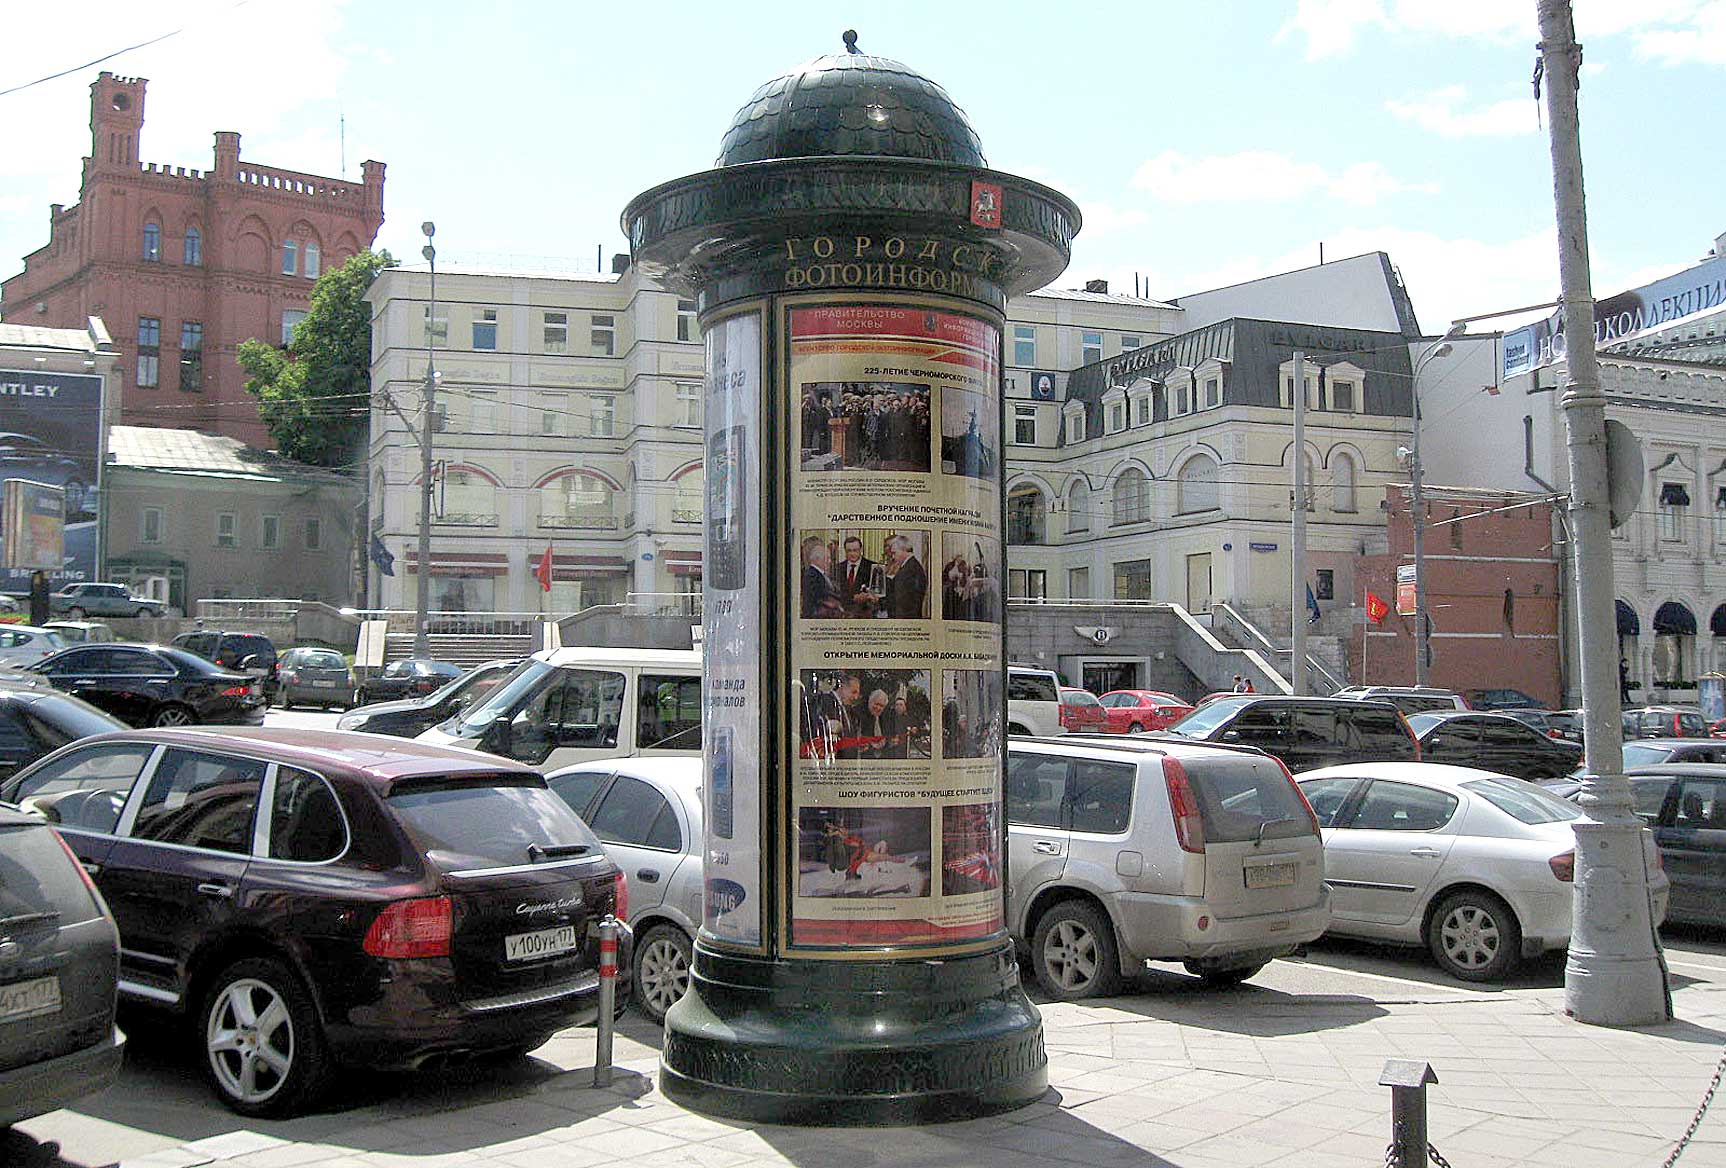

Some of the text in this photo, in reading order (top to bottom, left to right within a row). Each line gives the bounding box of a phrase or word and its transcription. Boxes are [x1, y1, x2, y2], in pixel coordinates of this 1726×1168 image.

[813, 309, 905, 320] ПРАВИТЕЛЬСТВО
[1603, 280, 1726, 343] КОЛЛЕКЦИ
[836, 320, 883, 330] МОСКВЫ
[864, 366, 909, 376] 225-ЛЕТИЕ
[877, 504, 920, 513] ВРУЧЕНИЕ
[921, 506, 959, 516] ПОЧЕТНОЙ
[894, 515, 948, 524] ПОДНОШЕНИЕ
[823, 651, 870, 659] ОТКРЫТИЕ
[871, 651, 939, 660] МЕМОРИАЛЬНОЙ
[838, 790, 859, 798] ШОУ
[860, 790, 916, 798] ФИГУРИСТОВ
